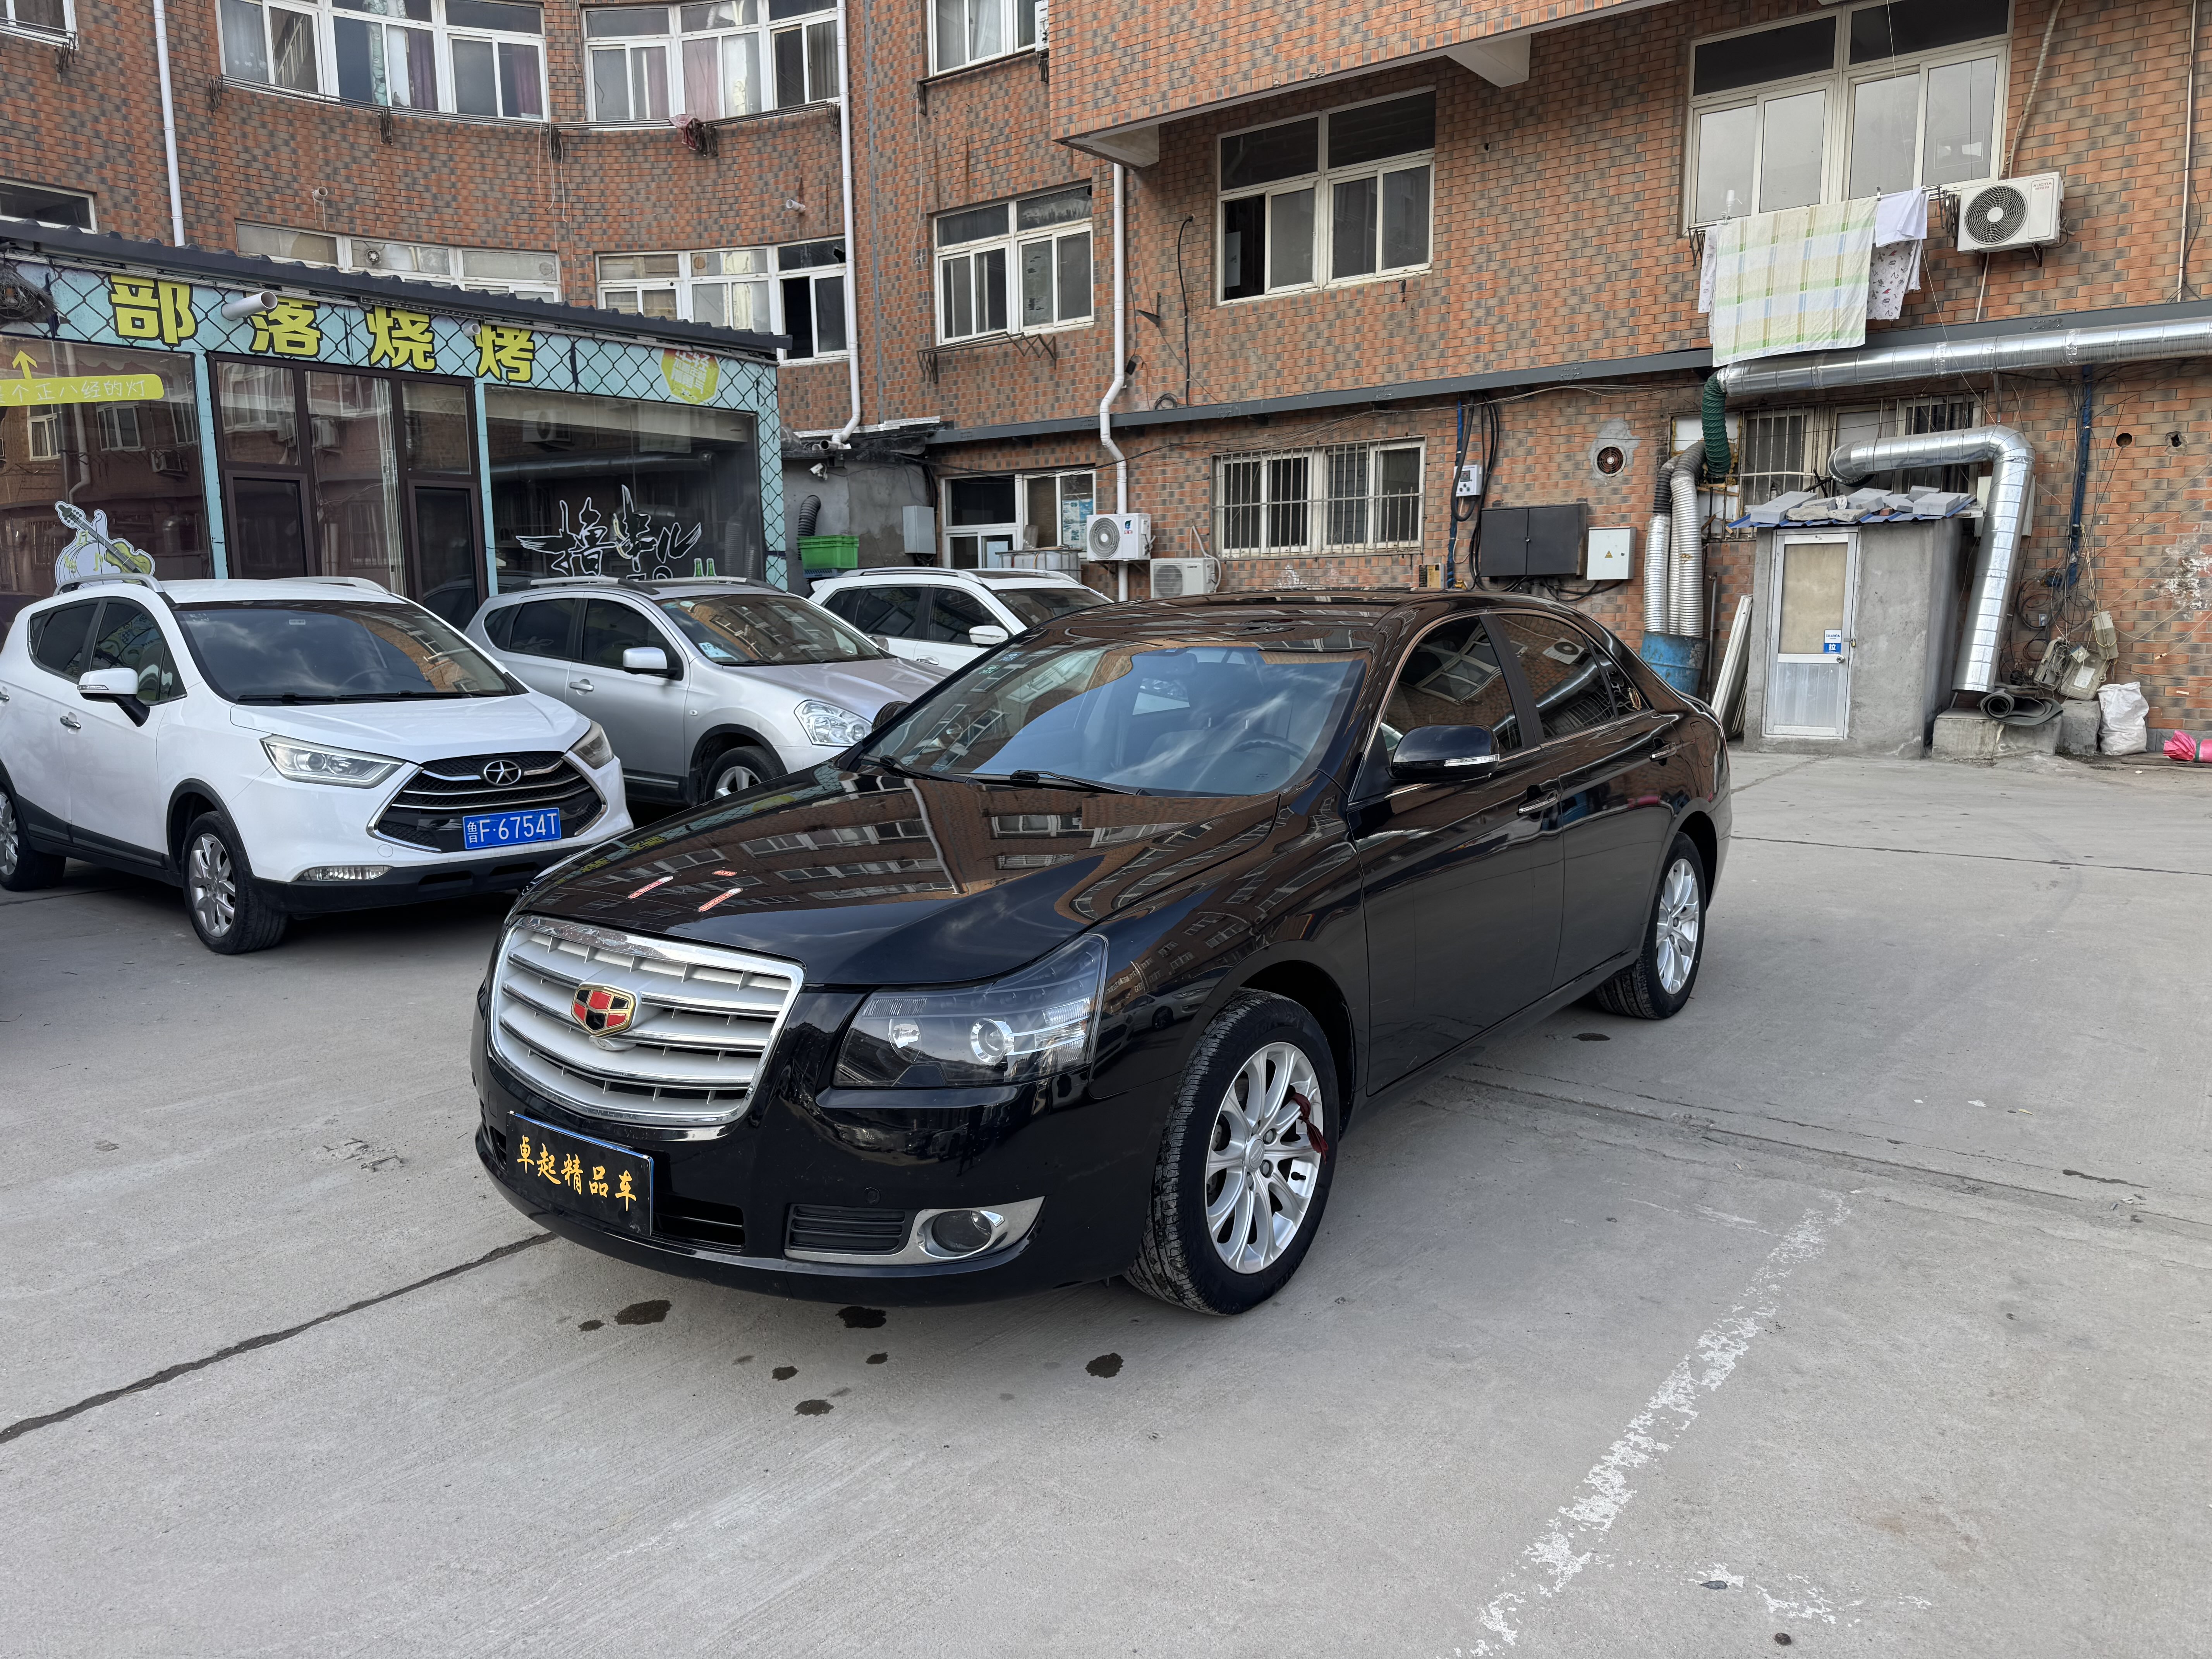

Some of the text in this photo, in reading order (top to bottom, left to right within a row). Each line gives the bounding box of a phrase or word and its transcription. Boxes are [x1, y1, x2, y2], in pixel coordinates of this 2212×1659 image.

[109, 274, 538, 383] 部落烧烤
[467, 813, 557, 843] 鲁F·6754T
